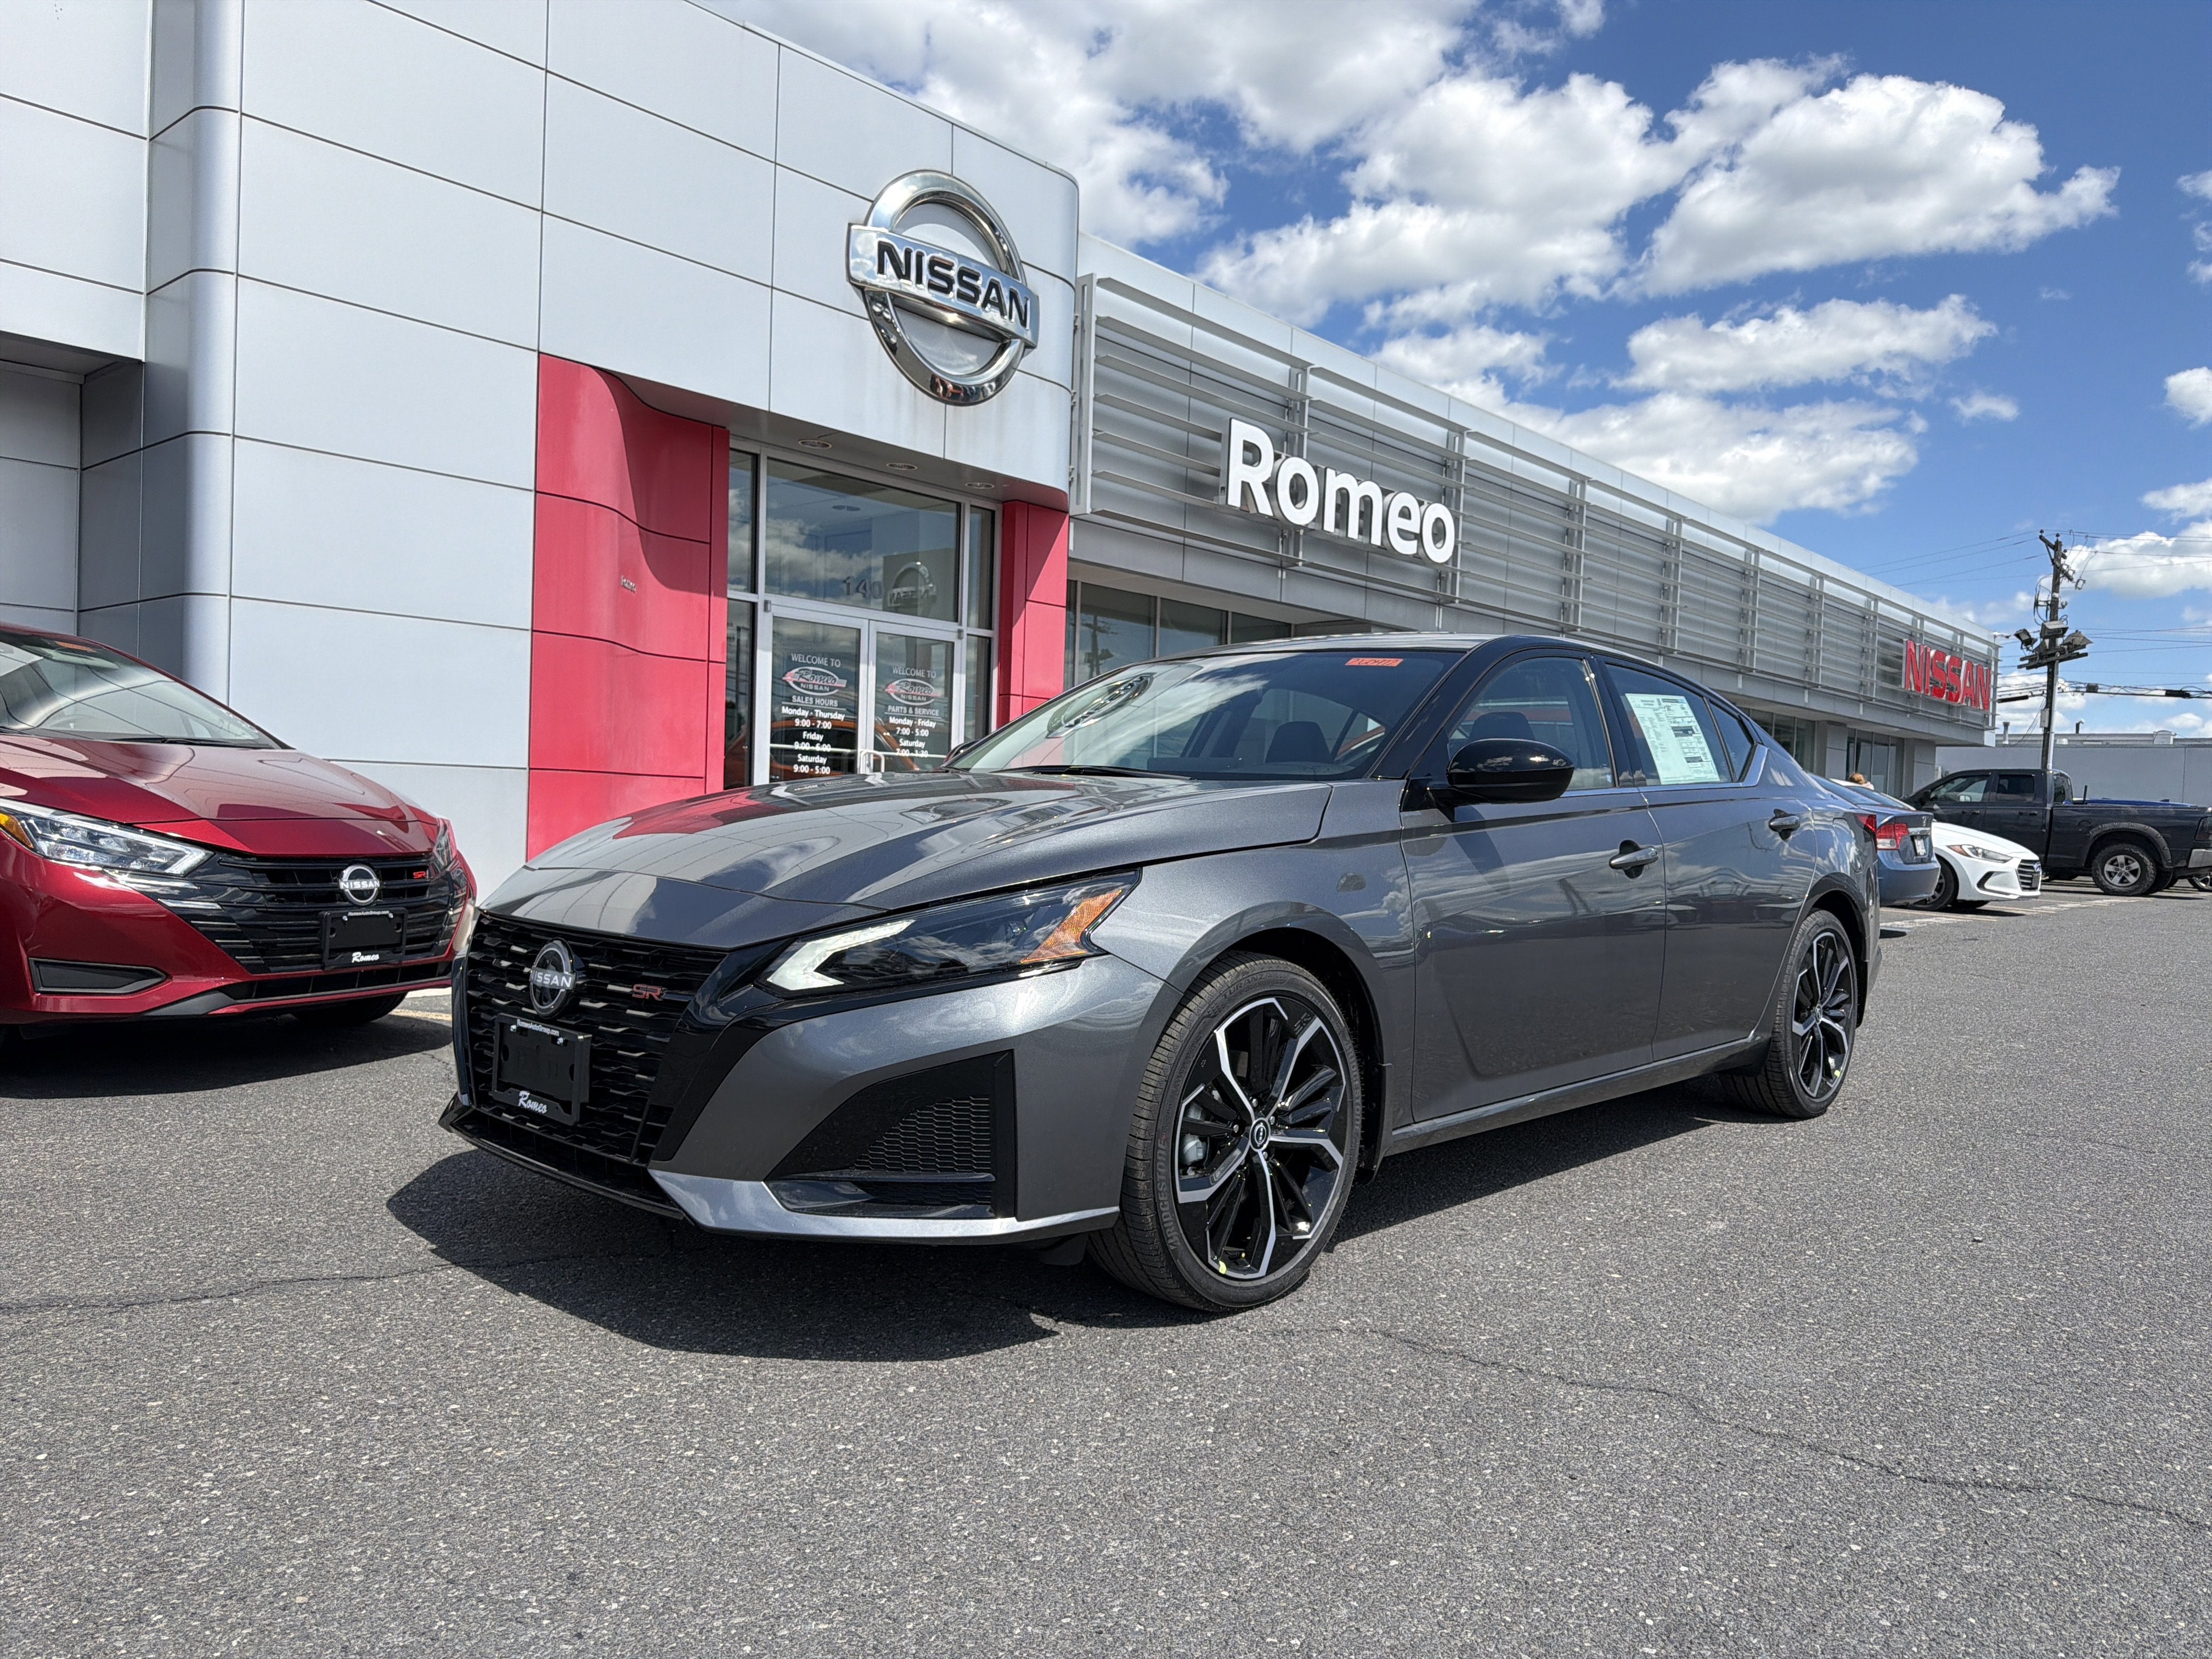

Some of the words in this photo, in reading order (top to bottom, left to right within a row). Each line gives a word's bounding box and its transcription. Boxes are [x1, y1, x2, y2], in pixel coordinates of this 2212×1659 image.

[877, 240, 1030, 329] NISSAN
[1227, 417, 1455, 563] Romeo
[791, 653, 828, 666] WELCOME
[830, 658, 841, 668] TO
[795, 669, 837, 684] Romeo
[893, 666, 926, 678] WELCOME
[927, 670, 936, 678] TO
[1904, 639, 1991, 712] NISSAN
[801, 683, 830, 691] NISSAN
[898, 680, 933, 694] Romeo
[792, 695, 814, 704] SALES
[815, 697, 838, 707] HOURS
[782, 706, 809, 718] Monday
[814, 709, 845, 721] Thursday
[888, 705, 907, 714] PARTS
[915, 708, 939, 716] SERVICE
[794, 718, 811, 727] 9:00
[816, 720, 832, 729] 7:00
[889, 716, 913, 727] Monday
[918, 719, 936, 729] Friday
[803, 731, 823, 742] Friday
[896, 727, 910, 735] 7:00
[915, 729, 929, 737] 5:00
[794, 741, 810, 751] 9:00
[899, 738, 926, 749] Saturday
[797, 754, 827, 765] Saturday
[793, 764, 809, 773] 9:00
[815, 766, 831, 775] 5:00
[413, 871, 426, 879] SR
[341, 880, 380, 889] NISSAN
[352, 952, 380, 963] Romeo
[632, 984, 661, 1001] SR
[518, 1091, 548, 1114] Romeo
